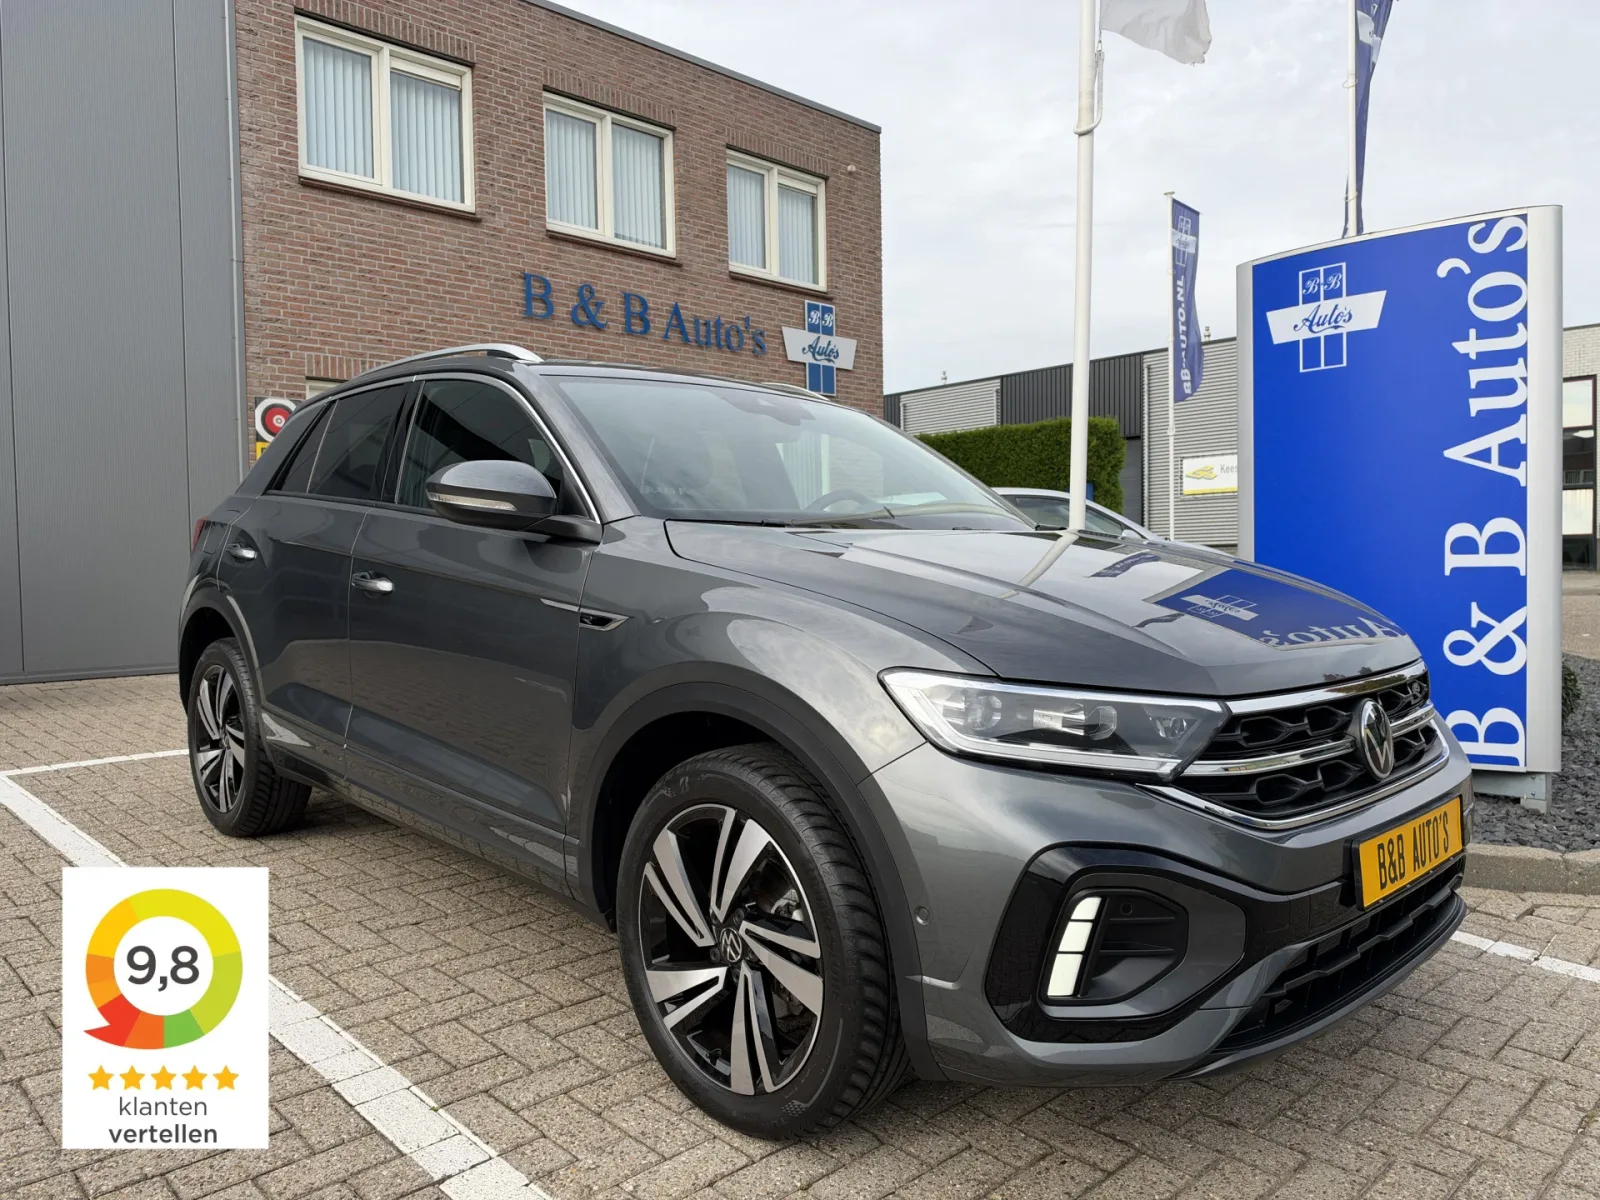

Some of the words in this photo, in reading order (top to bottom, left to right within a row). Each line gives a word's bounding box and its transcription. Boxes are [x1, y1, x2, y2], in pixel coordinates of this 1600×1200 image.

[521, 271, 555, 319] B
[570, 283, 608, 330] &
[620, 291, 651, 335] B
[663, 301, 767, 356] Auto's
[1293, 303, 1353, 334] Auto's
[802, 336, 839, 364] Auto's
[1436, 215, 1528, 487] Auto's
[1444, 517, 1527, 576] B
[1443, 602, 1527, 676] &
[1444, 706, 1526, 768] B
[1377, 833, 1406, 890] B&B
[1413, 810, 1449, 873] AUTO'S
